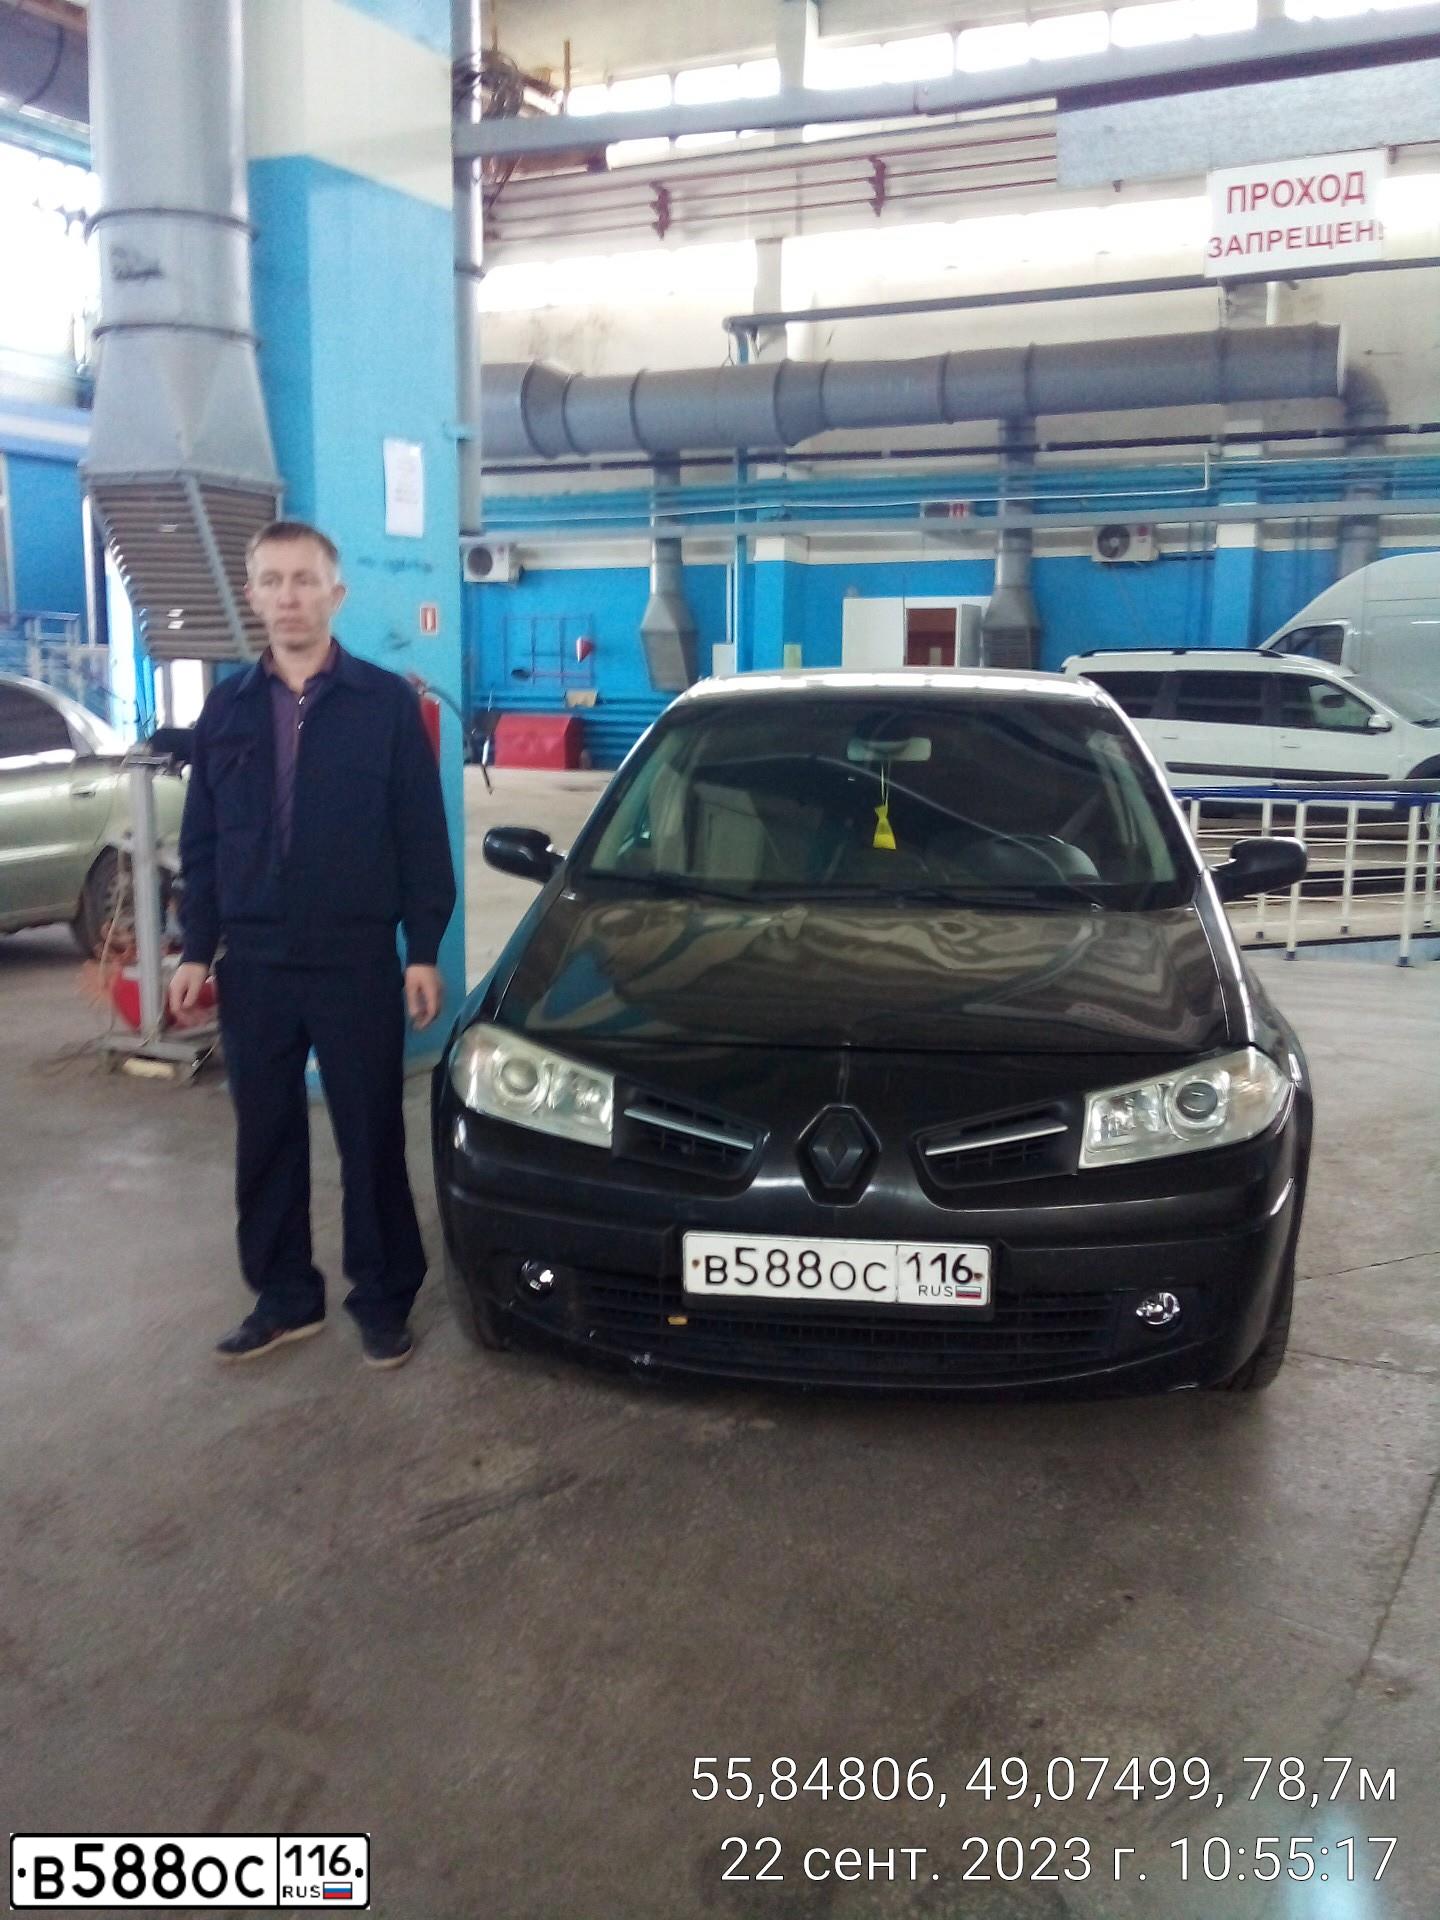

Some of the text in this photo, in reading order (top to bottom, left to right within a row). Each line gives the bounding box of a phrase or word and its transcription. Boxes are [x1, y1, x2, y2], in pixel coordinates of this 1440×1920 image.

[1226, 170, 1367, 214] ПРОХОД
[906, 1252, 974, 1285] 116
[917, 1284, 954, 1298] RUS
